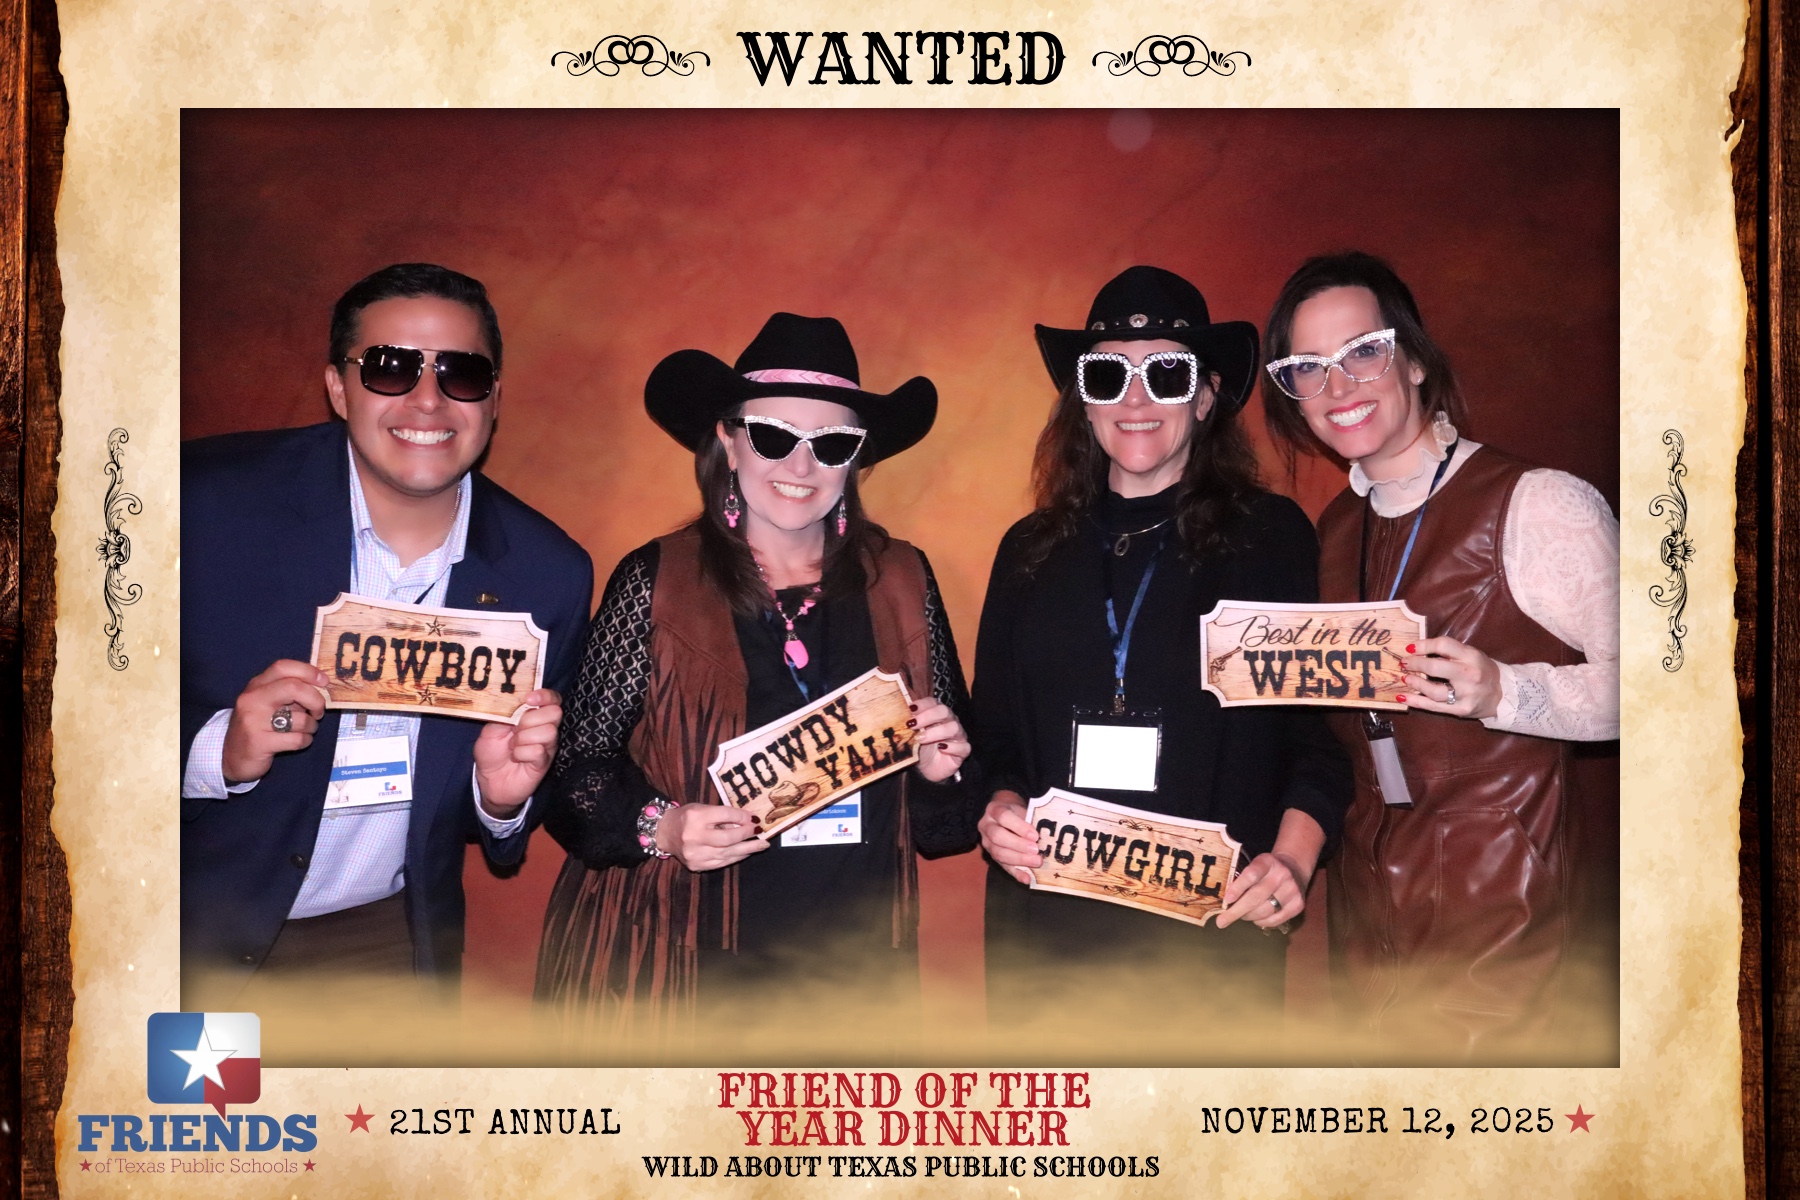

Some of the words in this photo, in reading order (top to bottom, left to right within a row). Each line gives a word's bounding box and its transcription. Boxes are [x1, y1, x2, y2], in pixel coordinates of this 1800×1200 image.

[335, 631, 527, 693] COWBOY
[1213, 615, 1313, 648] Best
[1311, 622, 1341, 646] in
[1348, 618, 1392, 646] the
[1243, 648, 1381, 698] WEST
[721, 694, 858, 808] HOWDY
[815, 727, 913, 789] Y'ALL
[1036, 818, 1222, 898] COWGIRL
